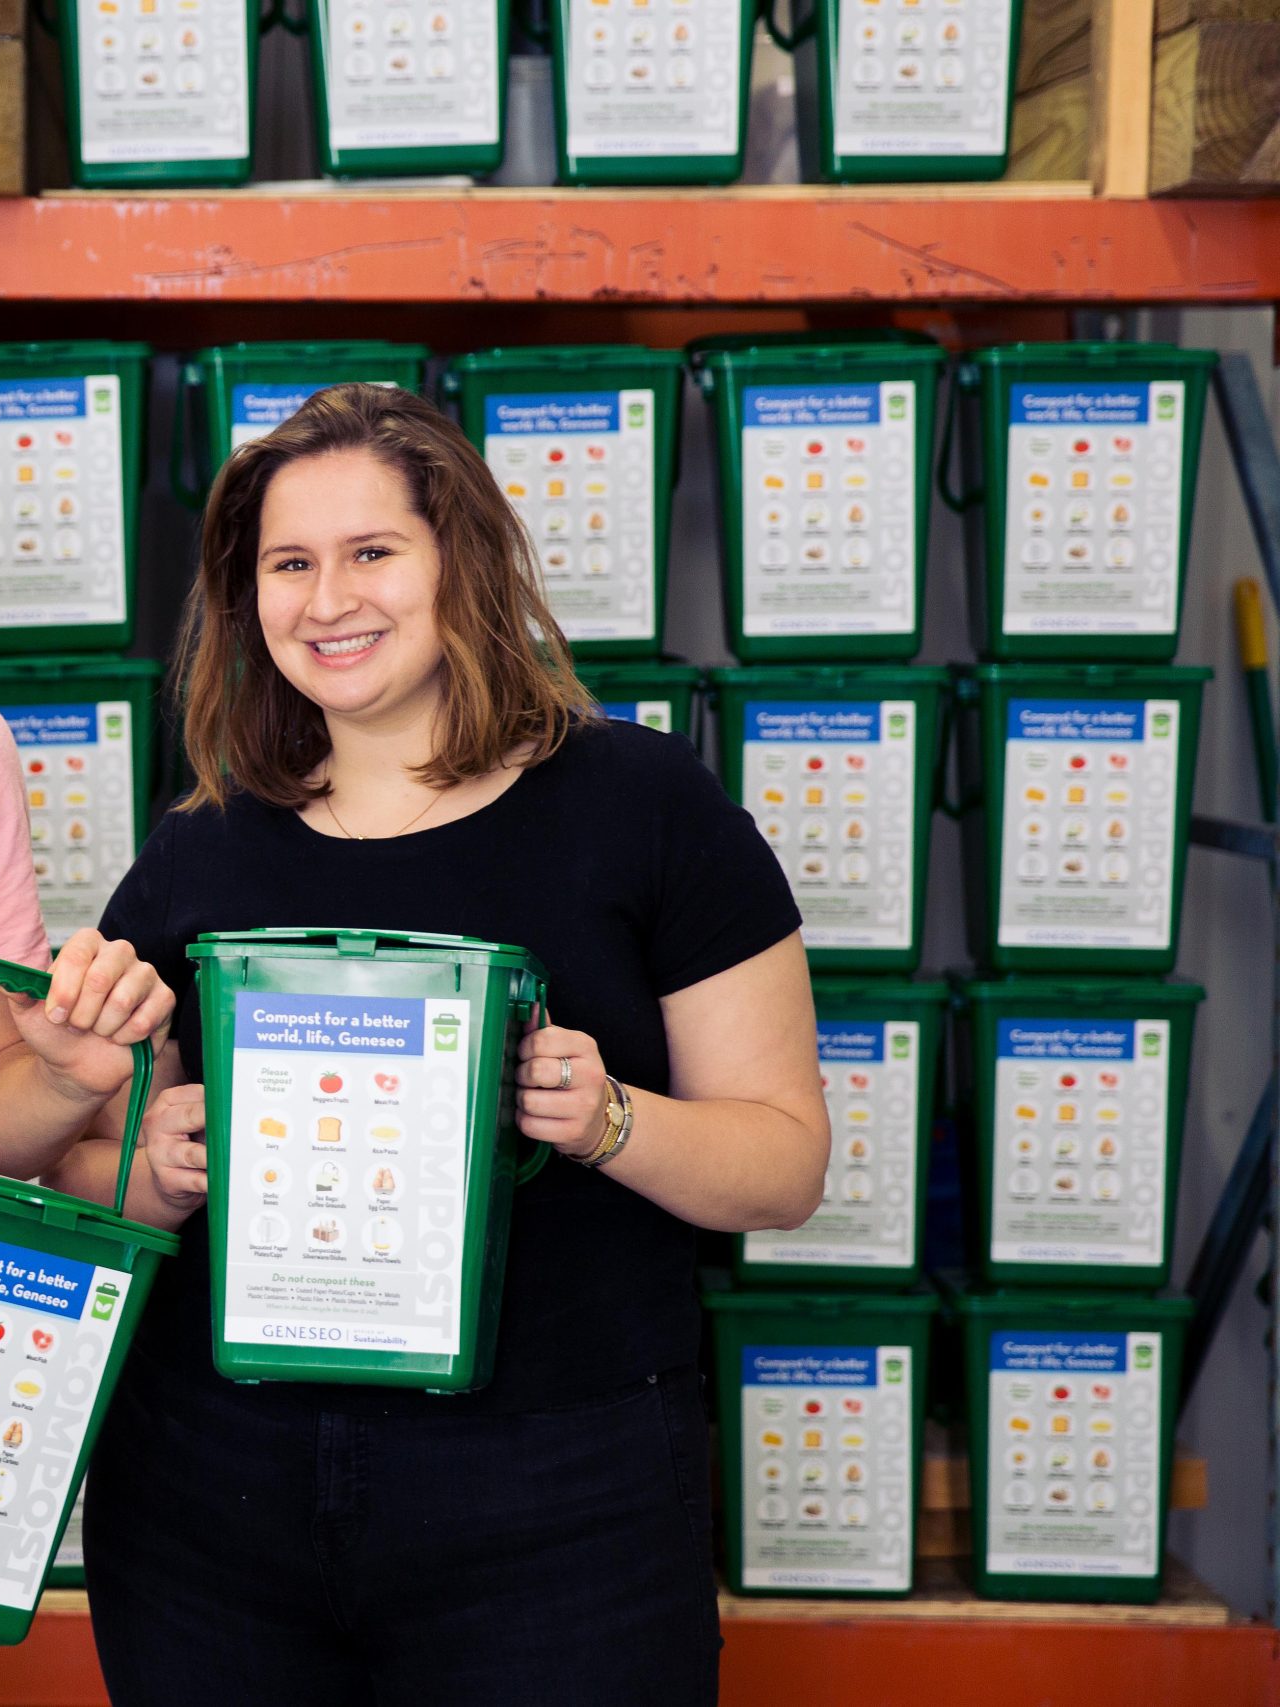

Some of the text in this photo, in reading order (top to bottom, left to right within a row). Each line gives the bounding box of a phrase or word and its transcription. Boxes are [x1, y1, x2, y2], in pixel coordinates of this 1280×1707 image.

[252, 1008, 410, 1028] Compost for a better
[256, 1027, 405, 1048] world, life, Geneseo
[257, 1076, 292, 1085] compost
[261, 1067, 288, 1076] Please
[415, 1065, 460, 1339] COMPOST
[5, 1260, 26, 1278] for
[26, 1270, 35, 1281] a
[36, 1268, 78, 1291] better
[272, 1273, 375, 1286] Do not compost these
[11, 1283, 68, 1309] Geneseo
[262, 1323, 341, 1341] GENESEO
[353, 1334, 407, 1345] Sustainability
[4, 1332, 104, 1595] COMPOST
